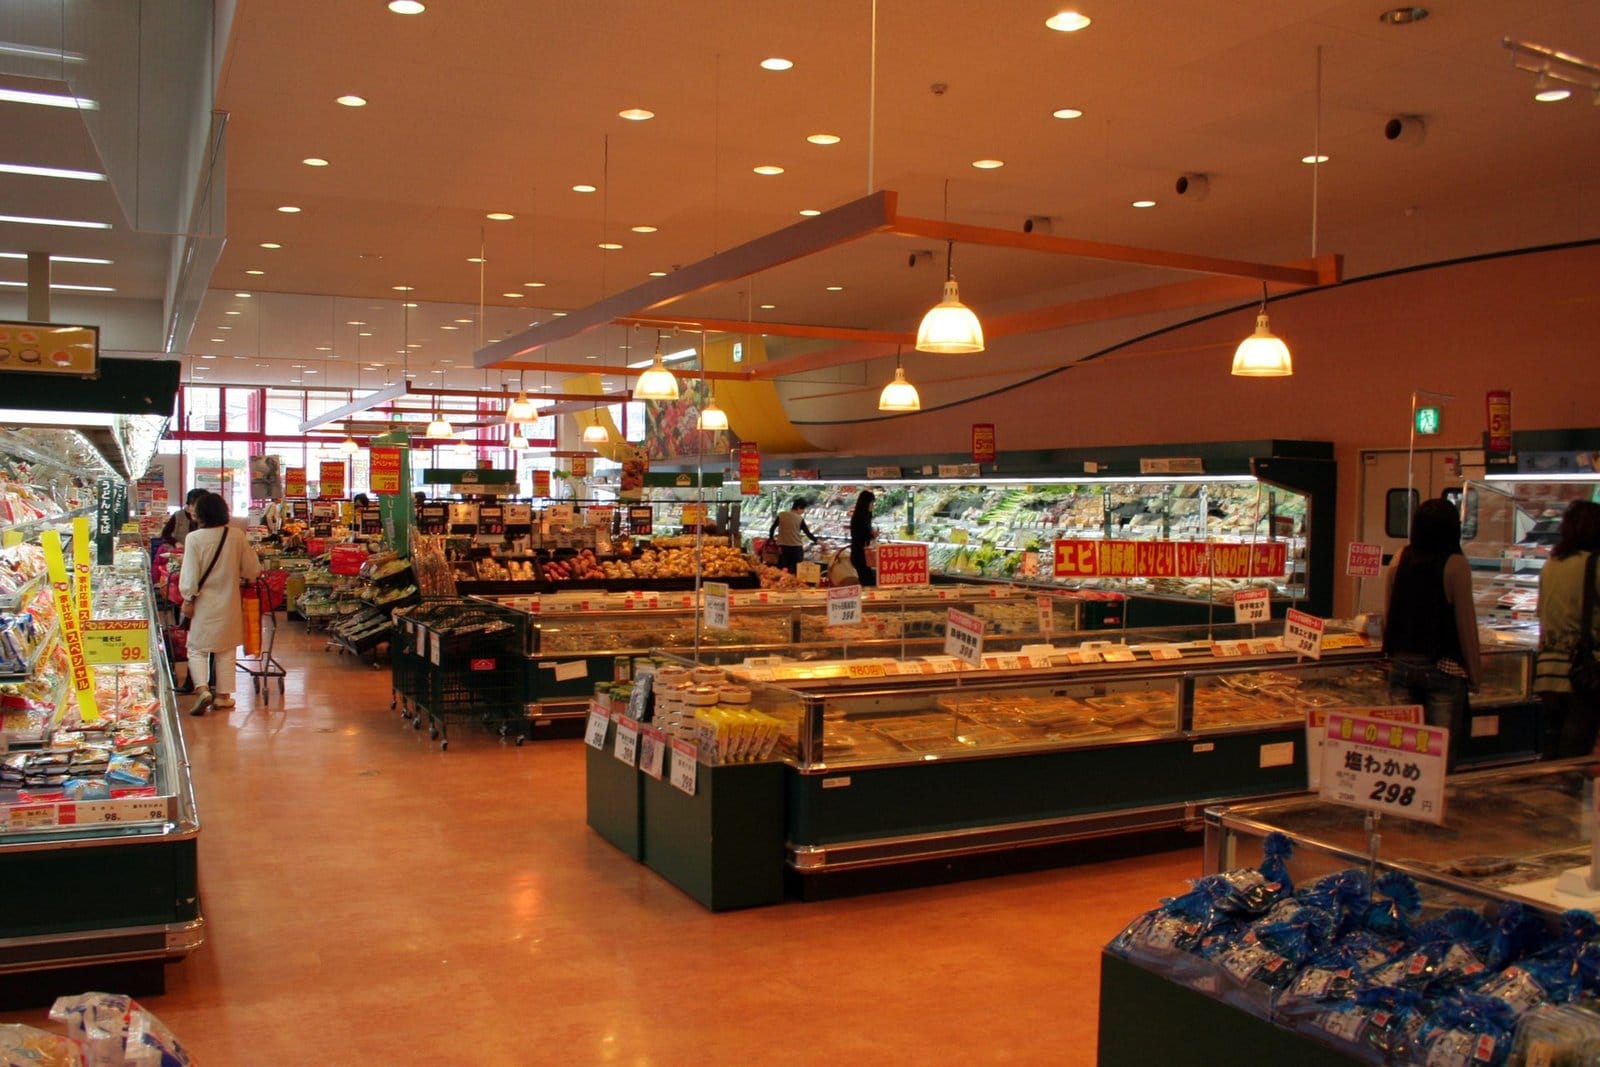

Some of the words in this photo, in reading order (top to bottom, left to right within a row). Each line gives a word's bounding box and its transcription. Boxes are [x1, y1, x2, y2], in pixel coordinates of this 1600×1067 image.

[101, 480, 112, 535] うどん・そば
[881, 559, 925, 571] 3パックで
[1057, 542, 1095, 573] エビ
[1138, 544, 1173, 575] よりどり
[1214, 545, 1249, 576] 980円
[106, 620, 148, 630] スペシャル
[66, 631, 90, 691] スペシャル
[121, 646, 142, 661] 99
[1344, 750, 1421, 782] 塩わかめ
[1369, 780, 1416, 807] 298
[1421, 799, 1433, 813] 円
[104, 813, 118, 822] 98
[150, 810, 163, 819] 98
